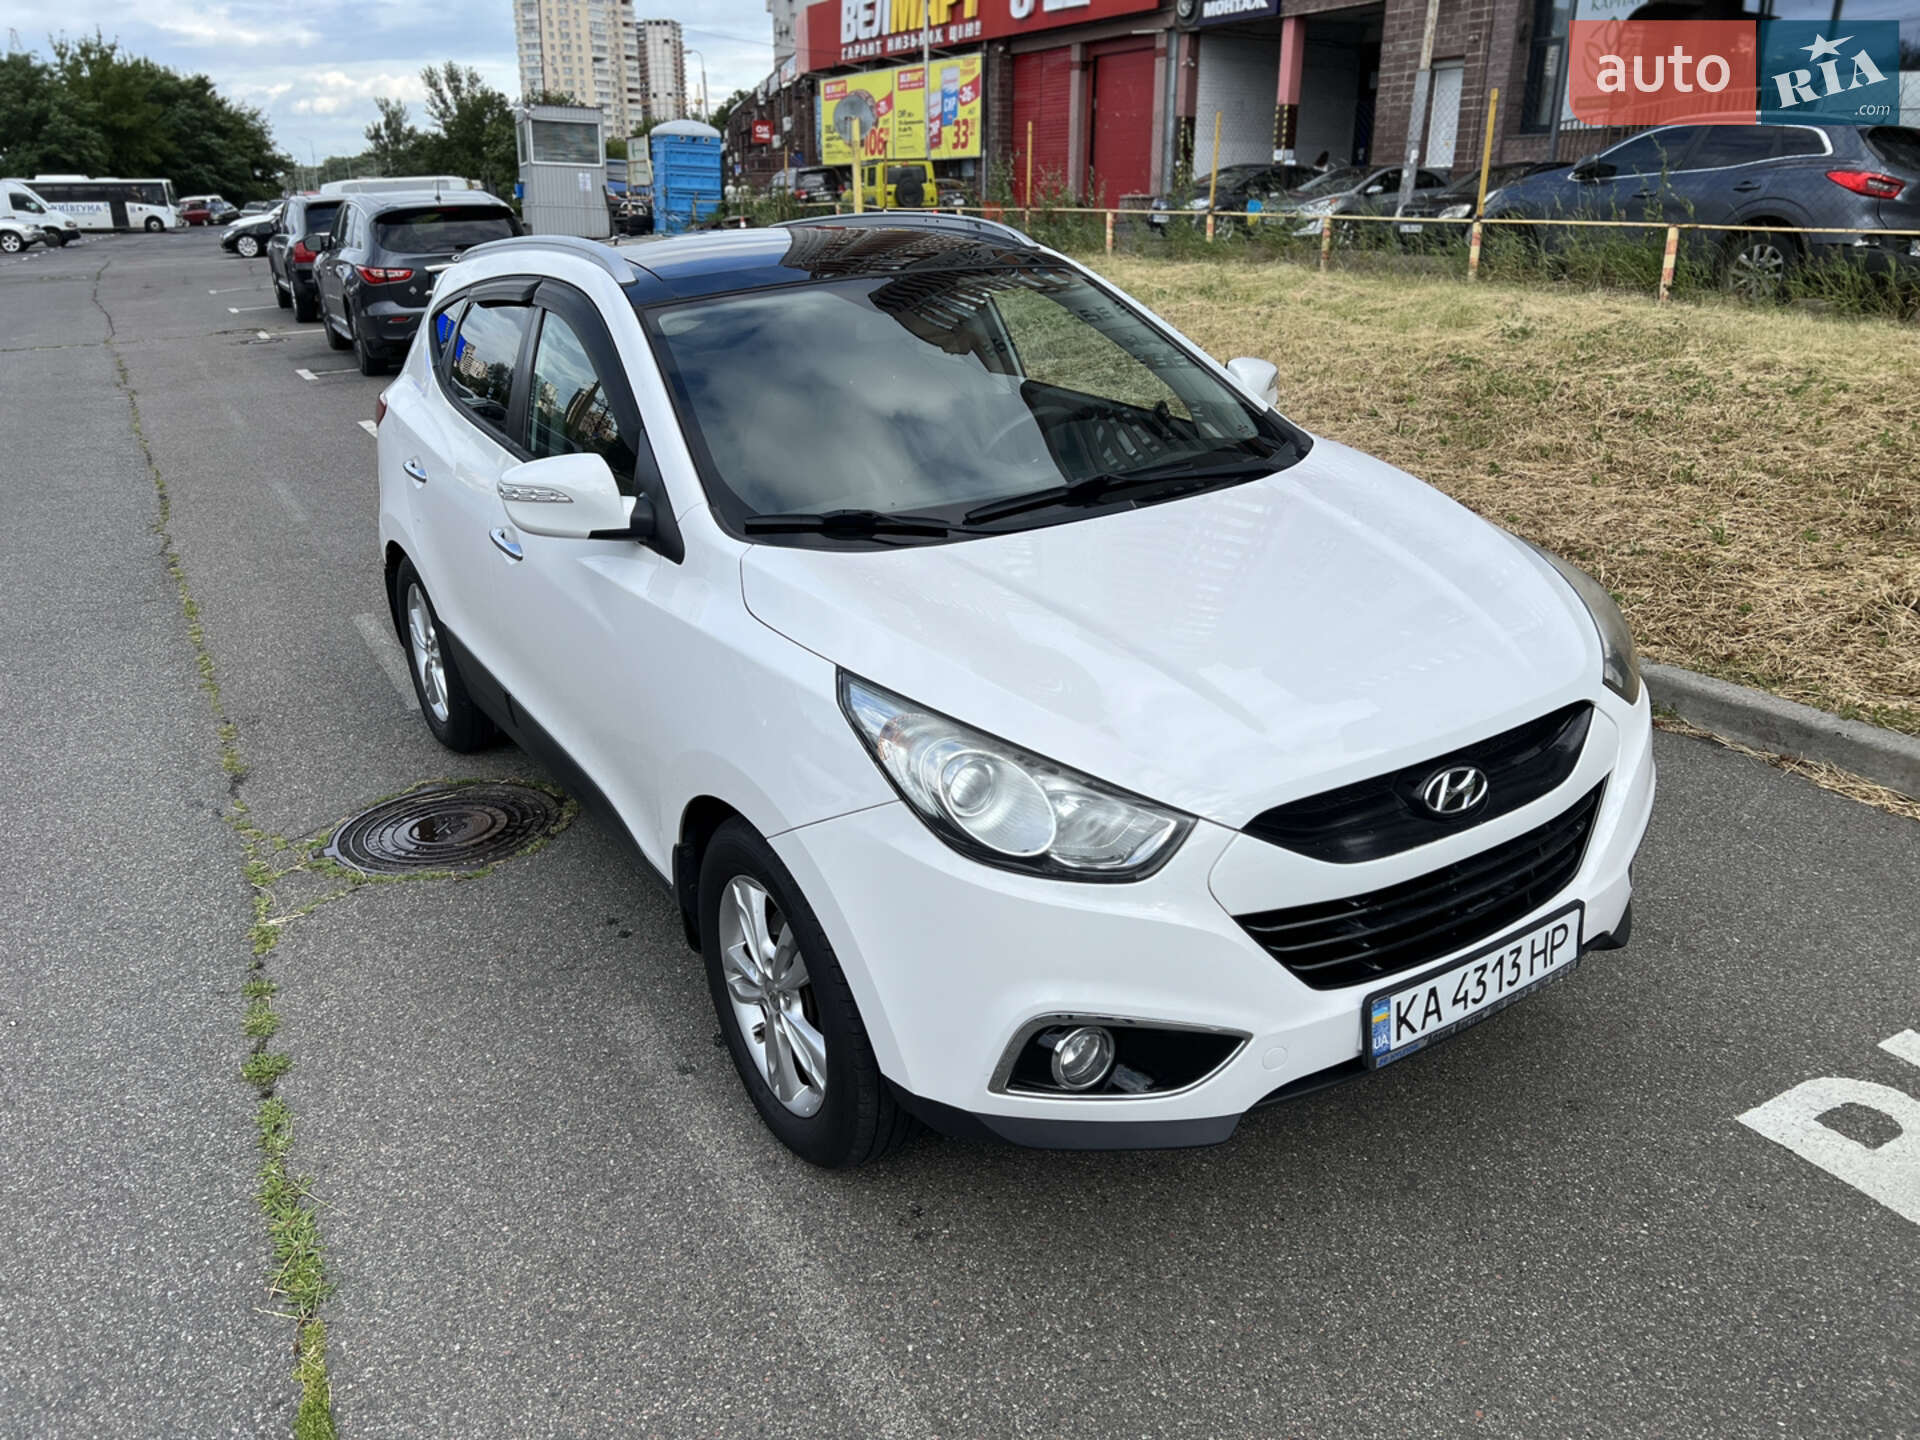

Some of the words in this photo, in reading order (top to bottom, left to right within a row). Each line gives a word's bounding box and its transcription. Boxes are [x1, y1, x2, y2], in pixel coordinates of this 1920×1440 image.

[841, 41, 882, 60] ГАРАНТ
[949, 20, 982, 43] ЦІН!
[952, 118, 969, 150] 33
[1396, 986, 1443, 1041] KA
[1451, 945, 1523, 1010] 4313
[1529, 923, 1569, 977] HP
[1372, 1033, 1389, 1050] UA
